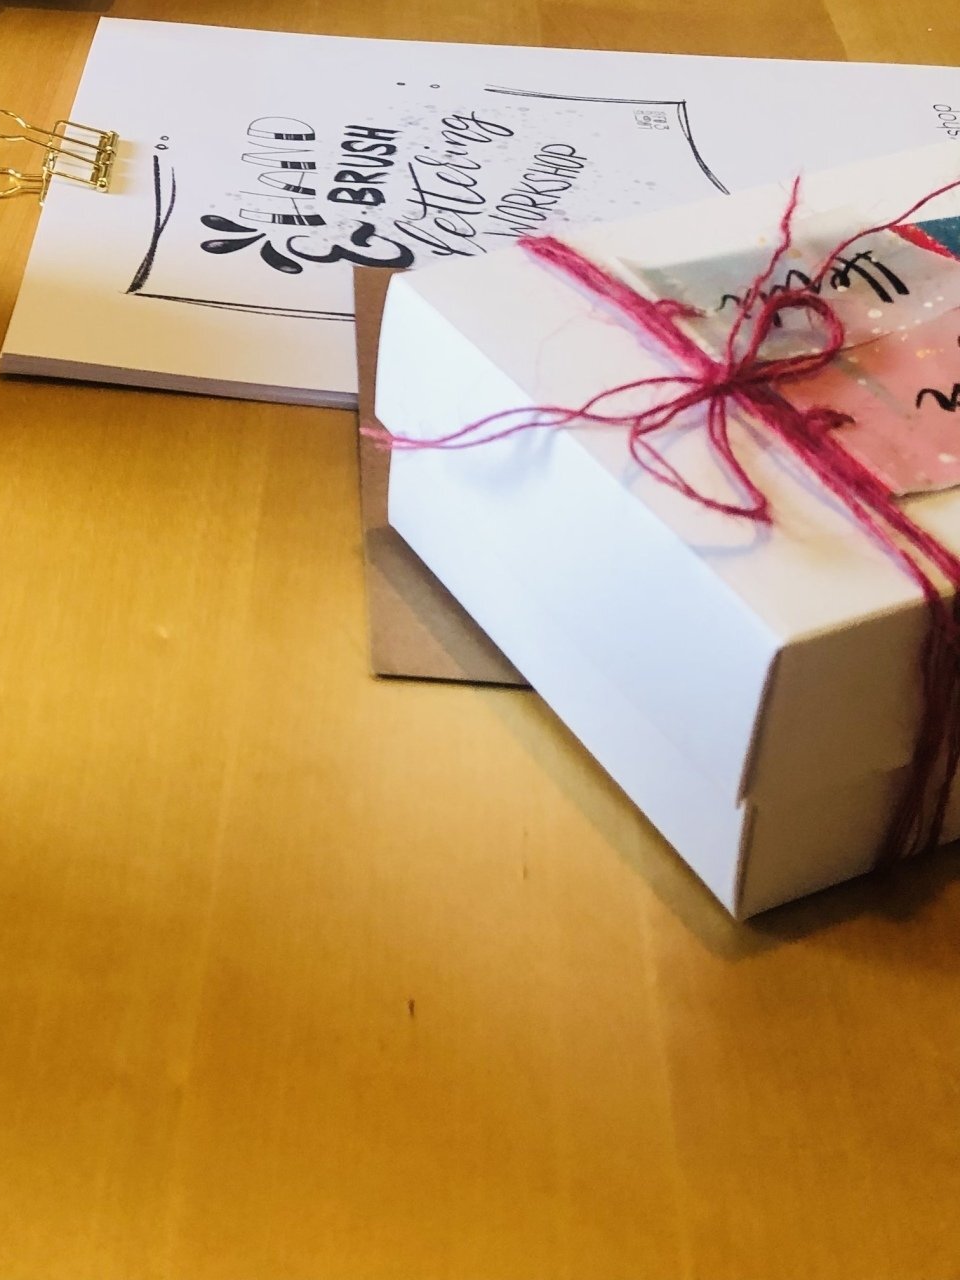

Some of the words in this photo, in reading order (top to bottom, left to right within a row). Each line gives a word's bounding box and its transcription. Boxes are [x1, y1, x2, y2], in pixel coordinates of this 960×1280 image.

[239, 116, 327, 226] HAND
[326, 124, 404, 207] BRUSH
[482, 143, 588, 238] WORKSHOP
